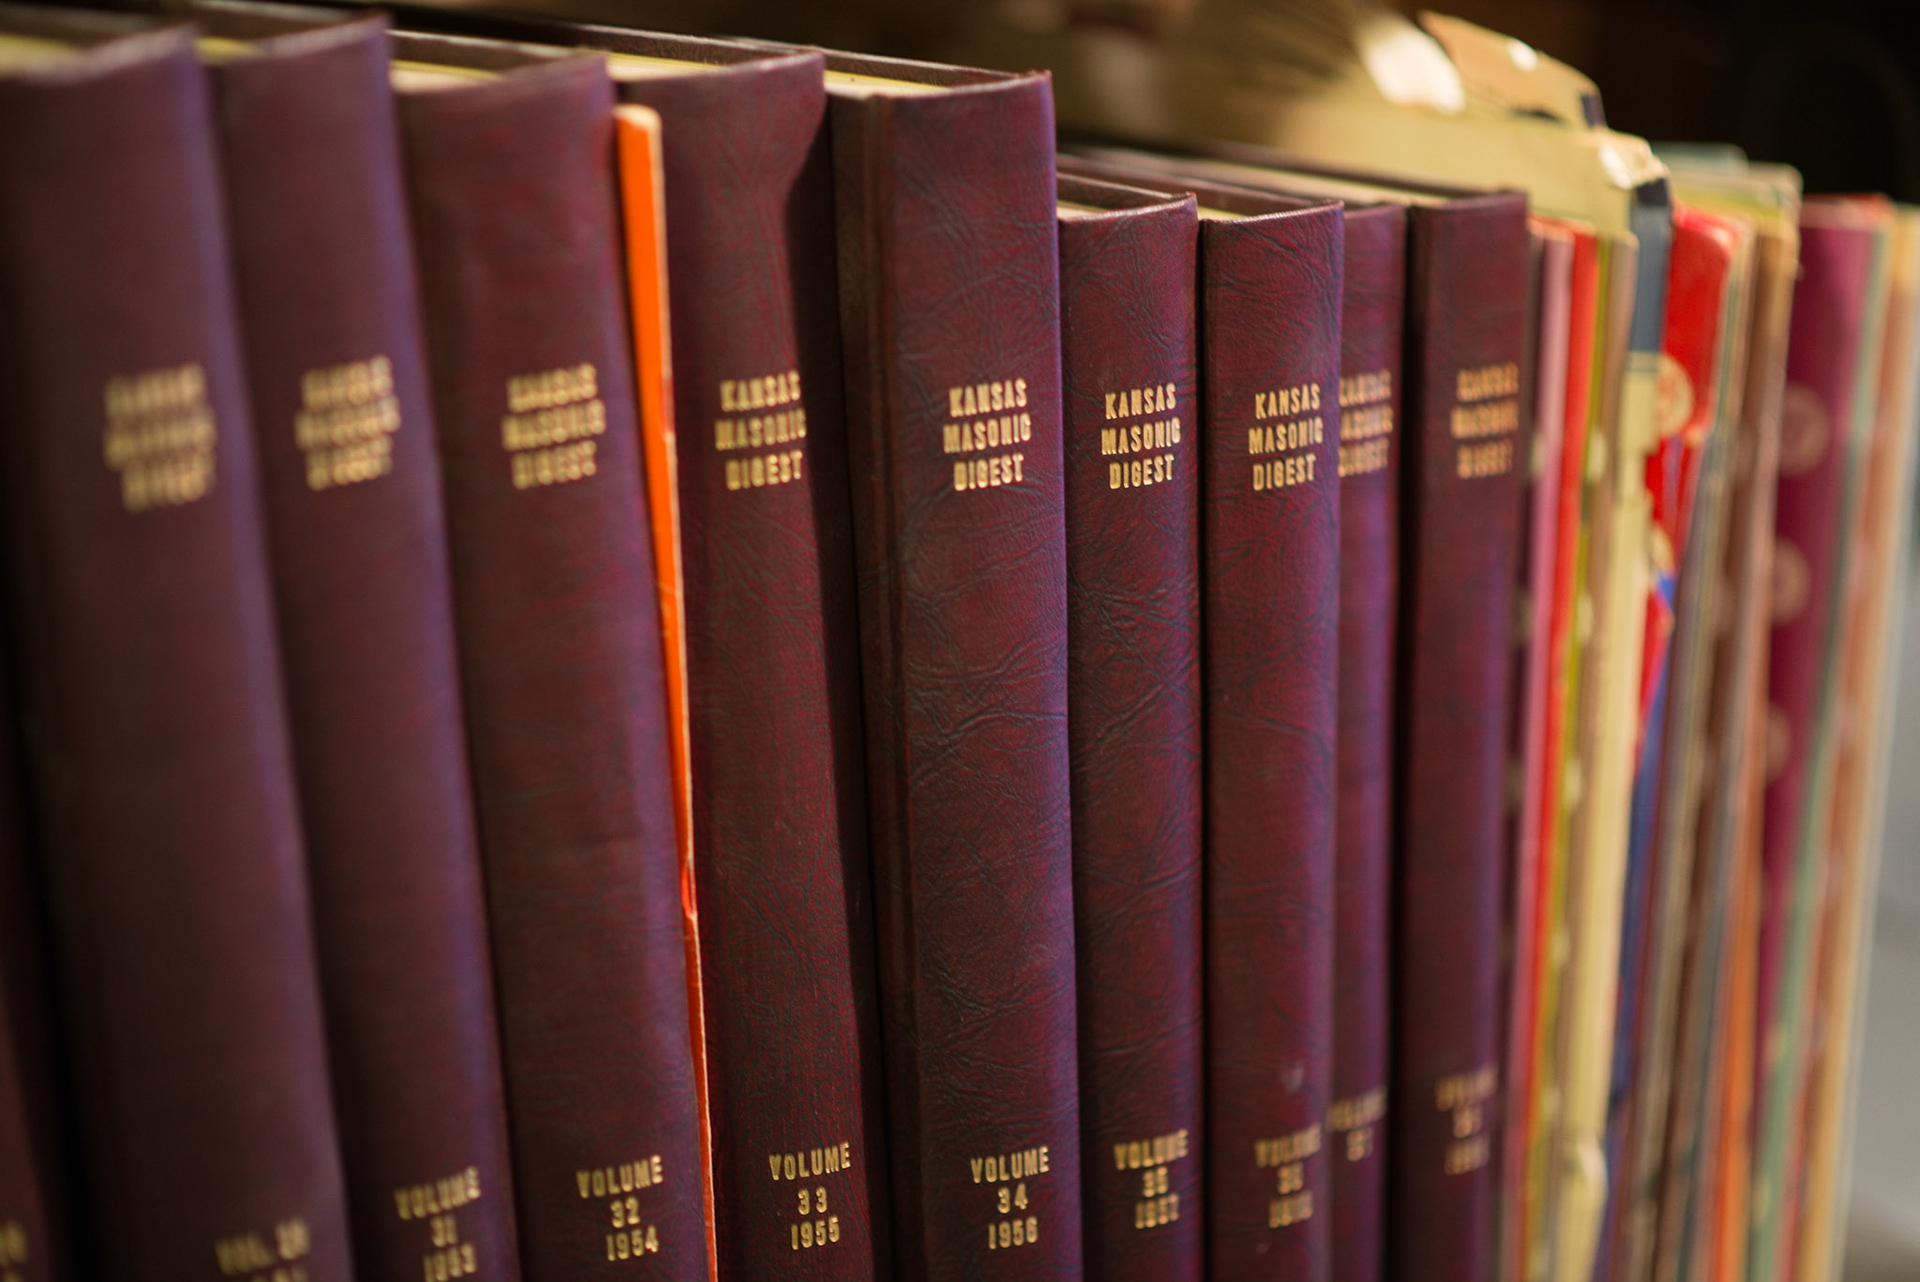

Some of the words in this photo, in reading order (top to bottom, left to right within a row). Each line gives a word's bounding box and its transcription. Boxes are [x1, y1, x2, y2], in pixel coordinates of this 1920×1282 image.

[721, 371, 801, 411] KANSAS
[949, 379, 1027, 417] KANSAS
[1105, 383, 1177, 419] KANSAS
[1255, 383, 1321, 419] KANSAS
[715, 408, 806, 450] MASONIC
[943, 413, 1031, 452] MASONIC
[1101, 417, 1181, 455] MASONIC
[1249, 417, 1323, 454] MASONIC
[726, 450, 803, 490] DIGEST
[954, 453, 1024, 491] DIGEST
[1109, 454, 1174, 489] DIGEST
[1253, 453, 1316, 490] DIGEST
[576, 1155, 663, 1199] VOLUME
[769, 1141, 850, 1180] VOLUME
[971, 1146, 1049, 1183] VOLUME
[611, 1197, 640, 1228] 32
[606, 1226, 659, 1261] 1954
[791, 1216, 839, 1250] 1955
[989, 1217, 1038, 1249] 1956
